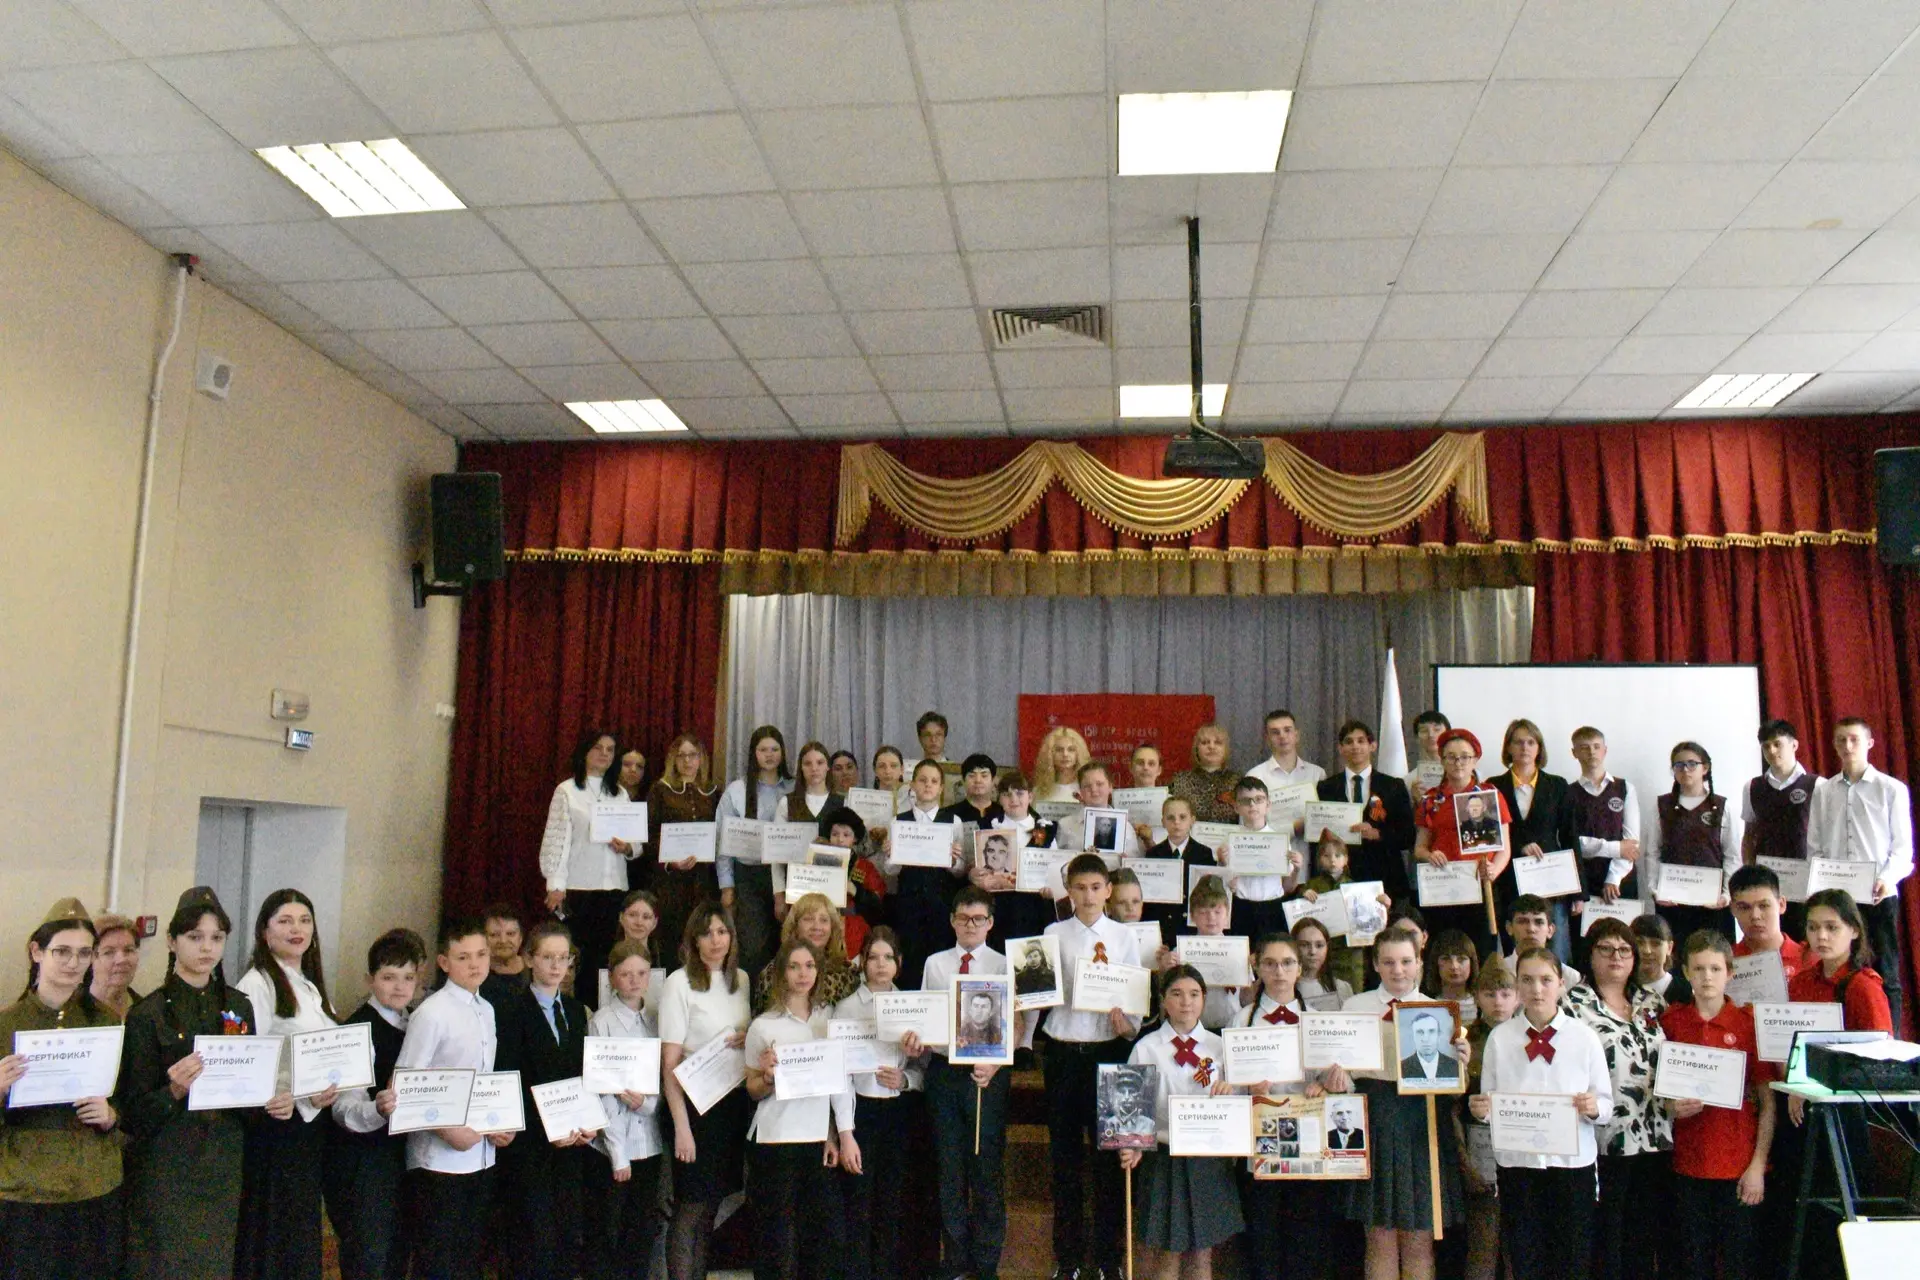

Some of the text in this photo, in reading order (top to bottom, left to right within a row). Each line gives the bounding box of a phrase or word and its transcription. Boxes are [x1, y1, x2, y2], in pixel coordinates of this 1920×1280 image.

[1271, 795, 1300, 805] ЕРТИФИКАТ
[898, 833, 934, 841] СЕРТИФИКАТ
[1666, 875, 1703, 883] СЕРТИФИКАТ
[1589, 907, 1625, 915] СЕРТИФИКАТ
[1083, 973, 1129, 984] СЕРТИФИКАТ
[1732, 969, 1763, 980] ИФИКАТ
[882, 1007, 928, 1015] СЕРТИФИКАТ
[1763, 1018, 1815, 1027] СЕРТИФИКАТ
[1309, 1029, 1357, 1037] СЕРТИФИКАТ
[1232, 1044, 1280, 1053] СЕРТИФИКАТ
[28, 1051, 93, 1062] СЕРТИФИКАТ
[592, 1054, 637, 1062] СЕРТИФИКАТ
[781, 1055, 824, 1065] СЕРТИФИКАТ
[203, 1057, 255, 1066] СЕРТИФИКАТ
[1667, 1058, 1719, 1071] СЕРТИФИКАТ
[400, 1085, 449, 1095] СЕРТИФИКАТ
[472, 1089, 501, 1098] ТИФИКАТ
[543, 1094, 579, 1108] СЕРТИФИКАТ
[1178, 1113, 1228, 1121] СЕРТИФИКАТ
[1499, 1109, 1552, 1119] СЕРТИФИКАТ
